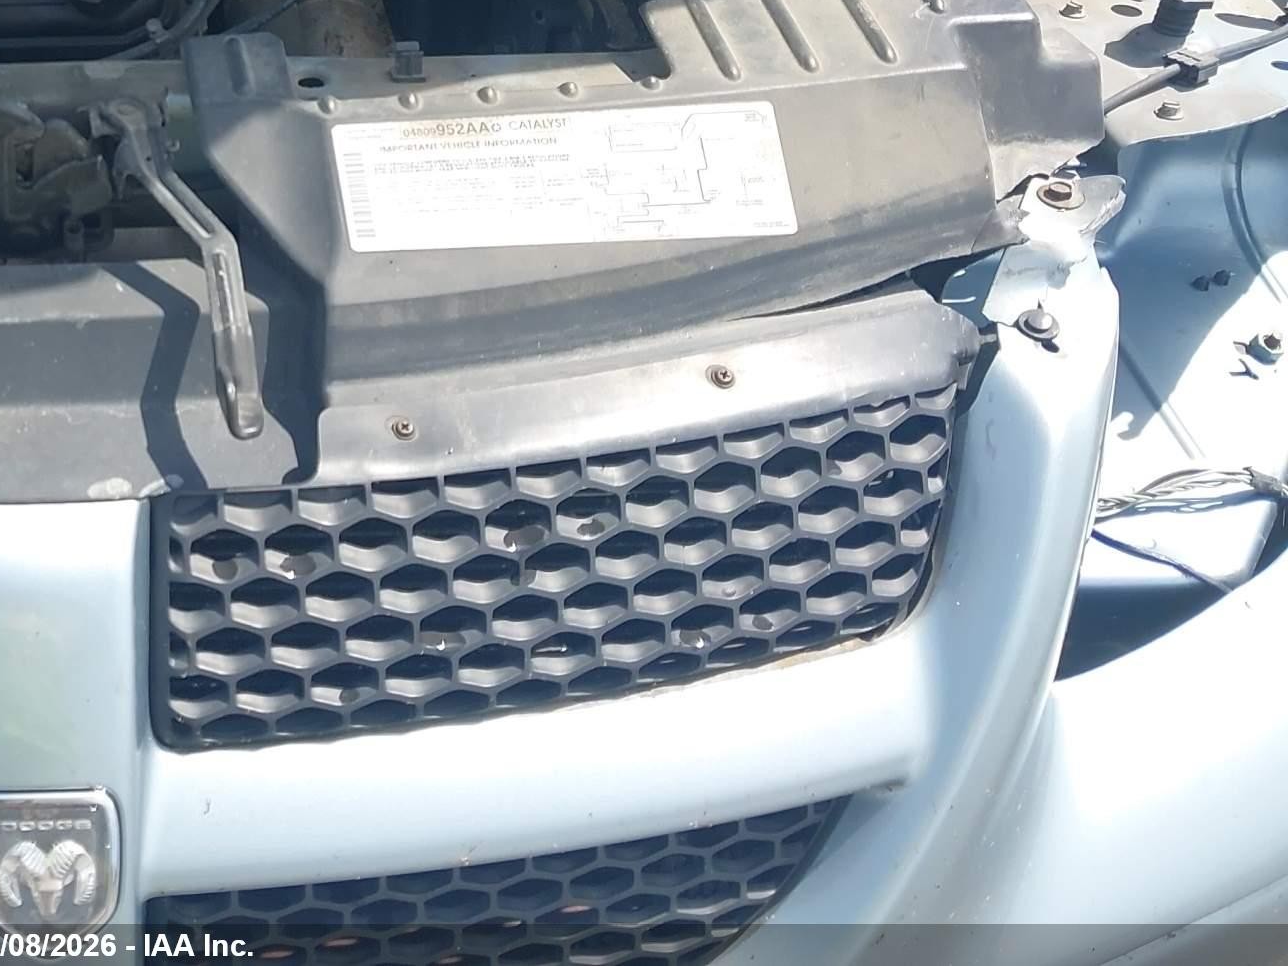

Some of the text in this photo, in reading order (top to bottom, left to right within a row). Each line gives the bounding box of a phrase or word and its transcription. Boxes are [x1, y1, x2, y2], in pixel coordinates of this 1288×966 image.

[509, 118, 568, 130] CATALYST
[379, 137, 558, 152] IMPORTANT VEHICLE INFORMATION
[0, 819, 93, 832] DODGE
